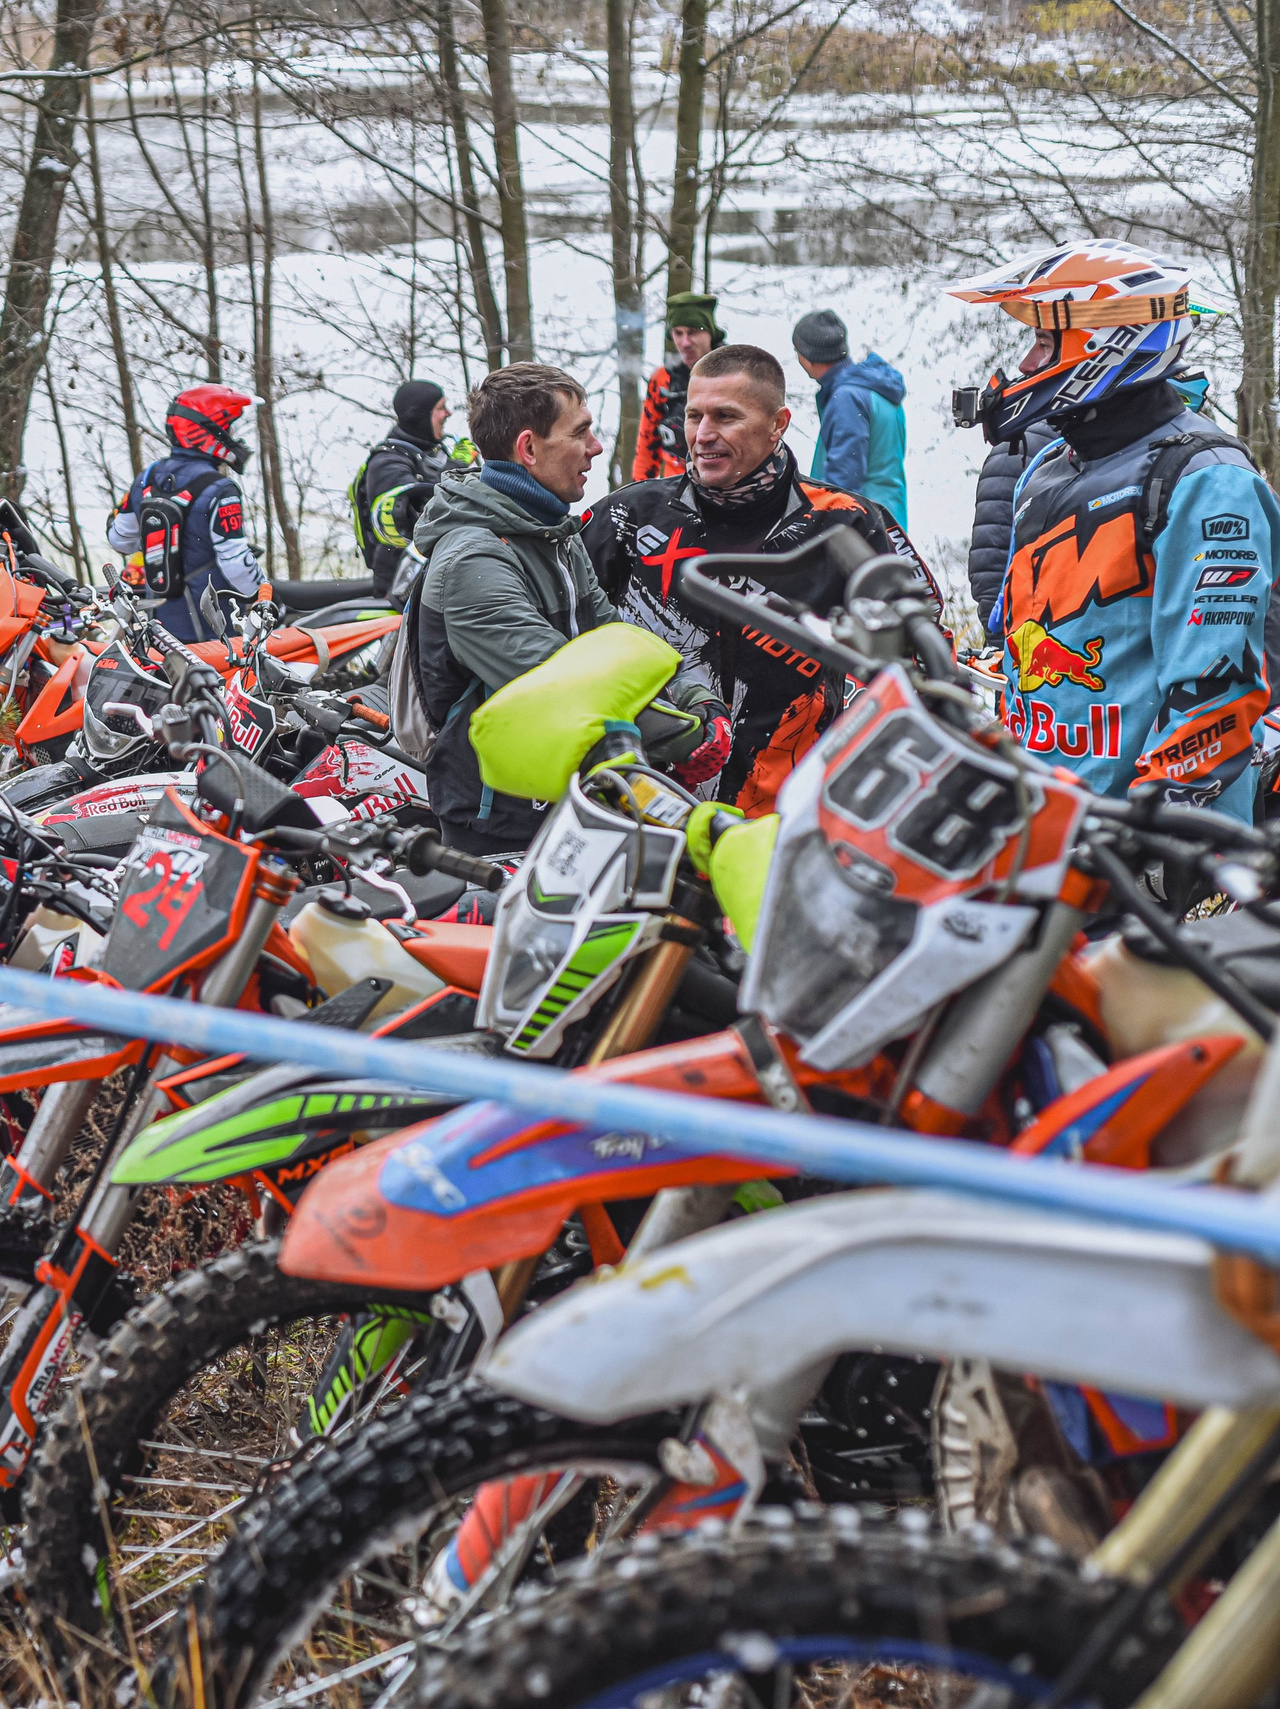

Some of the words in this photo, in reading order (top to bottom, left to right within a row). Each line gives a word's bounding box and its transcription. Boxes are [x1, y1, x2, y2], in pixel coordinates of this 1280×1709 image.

[1102, 486, 1141, 505] MOTOREX
[1208, 521, 1244, 536] 100%
[1205, 549, 1259, 561] MOTOREX
[1004, 512, 1141, 637] TM
[1202, 571, 1251, 584] WP
[95, 658, 120, 669] KTM
[1025, 700, 1122, 759] Bull
[1167, 740, 1222, 779] MOTO
[86, 801, 119, 816] Red
[120, 794, 147, 813] Bull
[824, 706, 1045, 882] 68
[122, 851, 205, 951] 24
